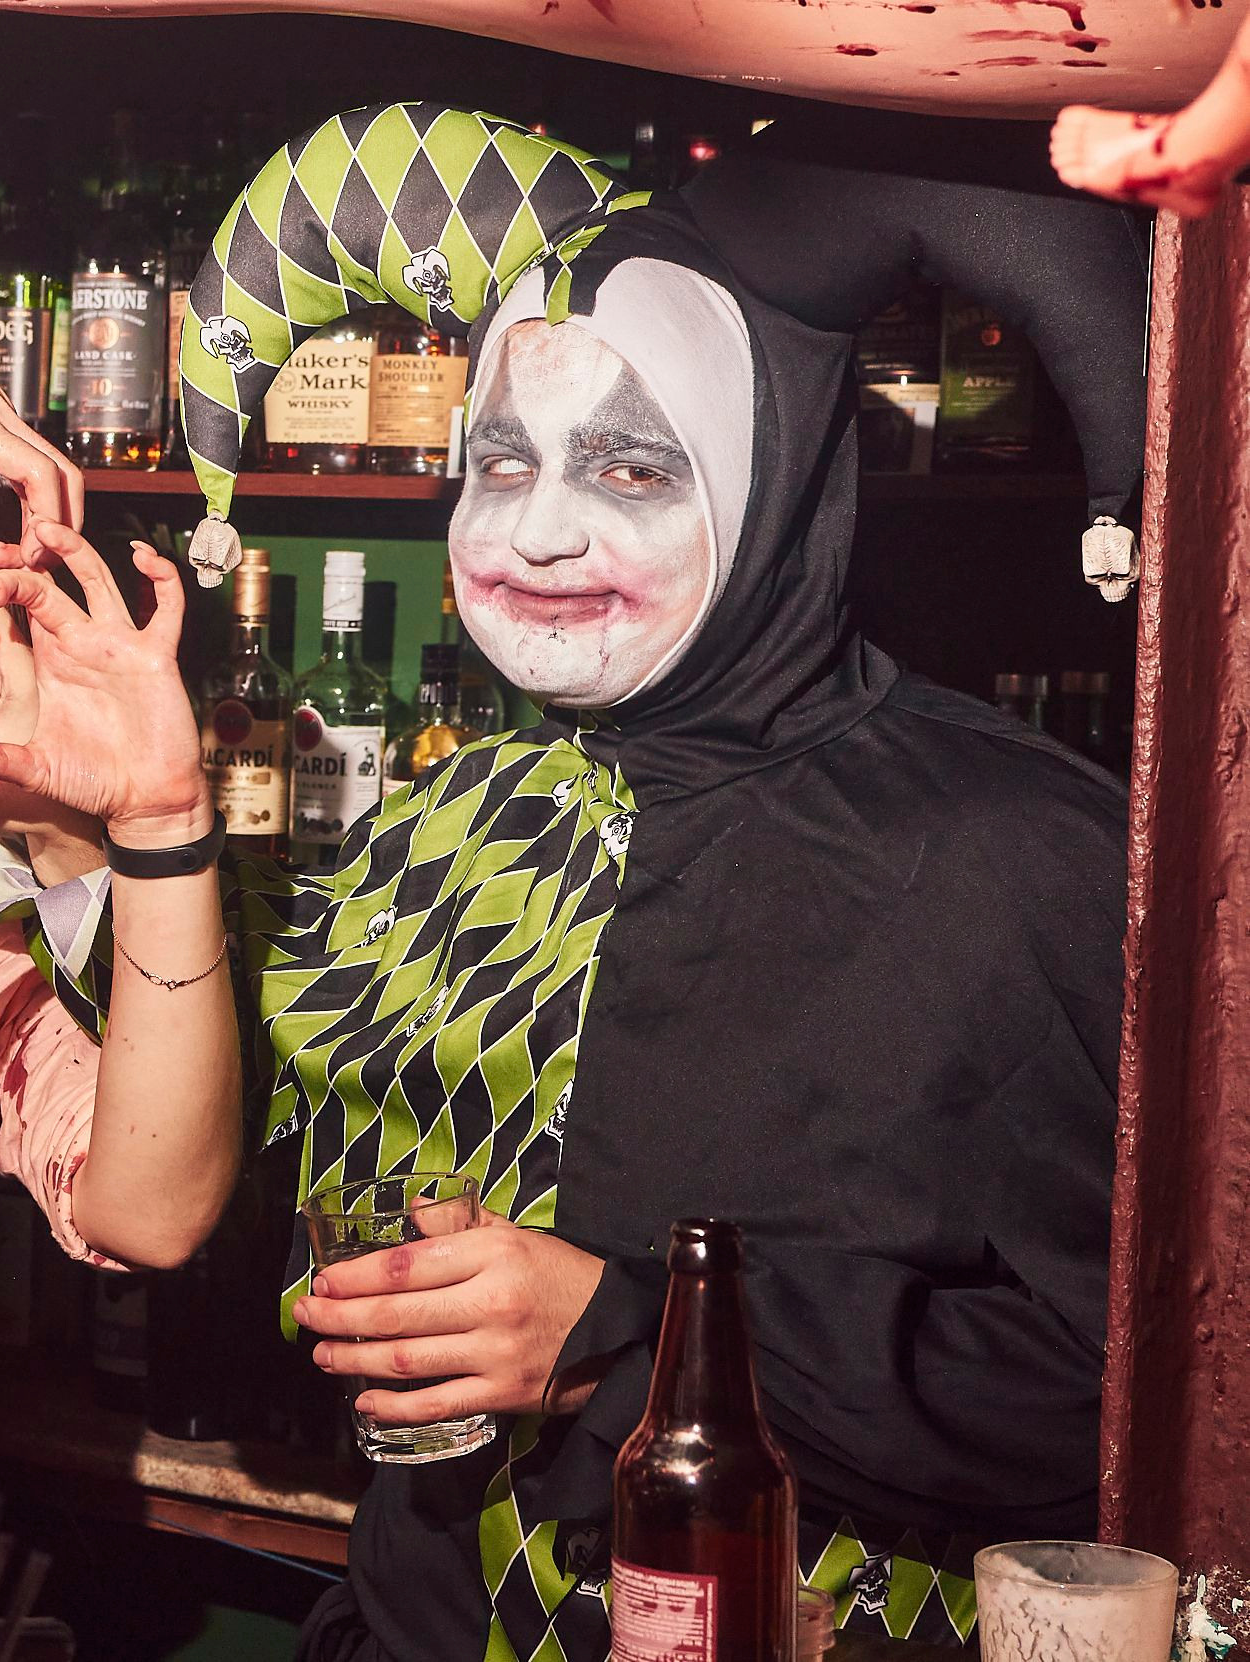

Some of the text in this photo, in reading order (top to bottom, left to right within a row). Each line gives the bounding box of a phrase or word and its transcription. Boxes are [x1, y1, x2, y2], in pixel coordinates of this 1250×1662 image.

[382, 360, 438, 370] MONKEY
[300, 374, 367, 390] Mark
[378, 372, 444, 382] SHOULDER
[287, 399, 353, 409] WHISKY
[293, 752, 347, 776] CARDÍ
